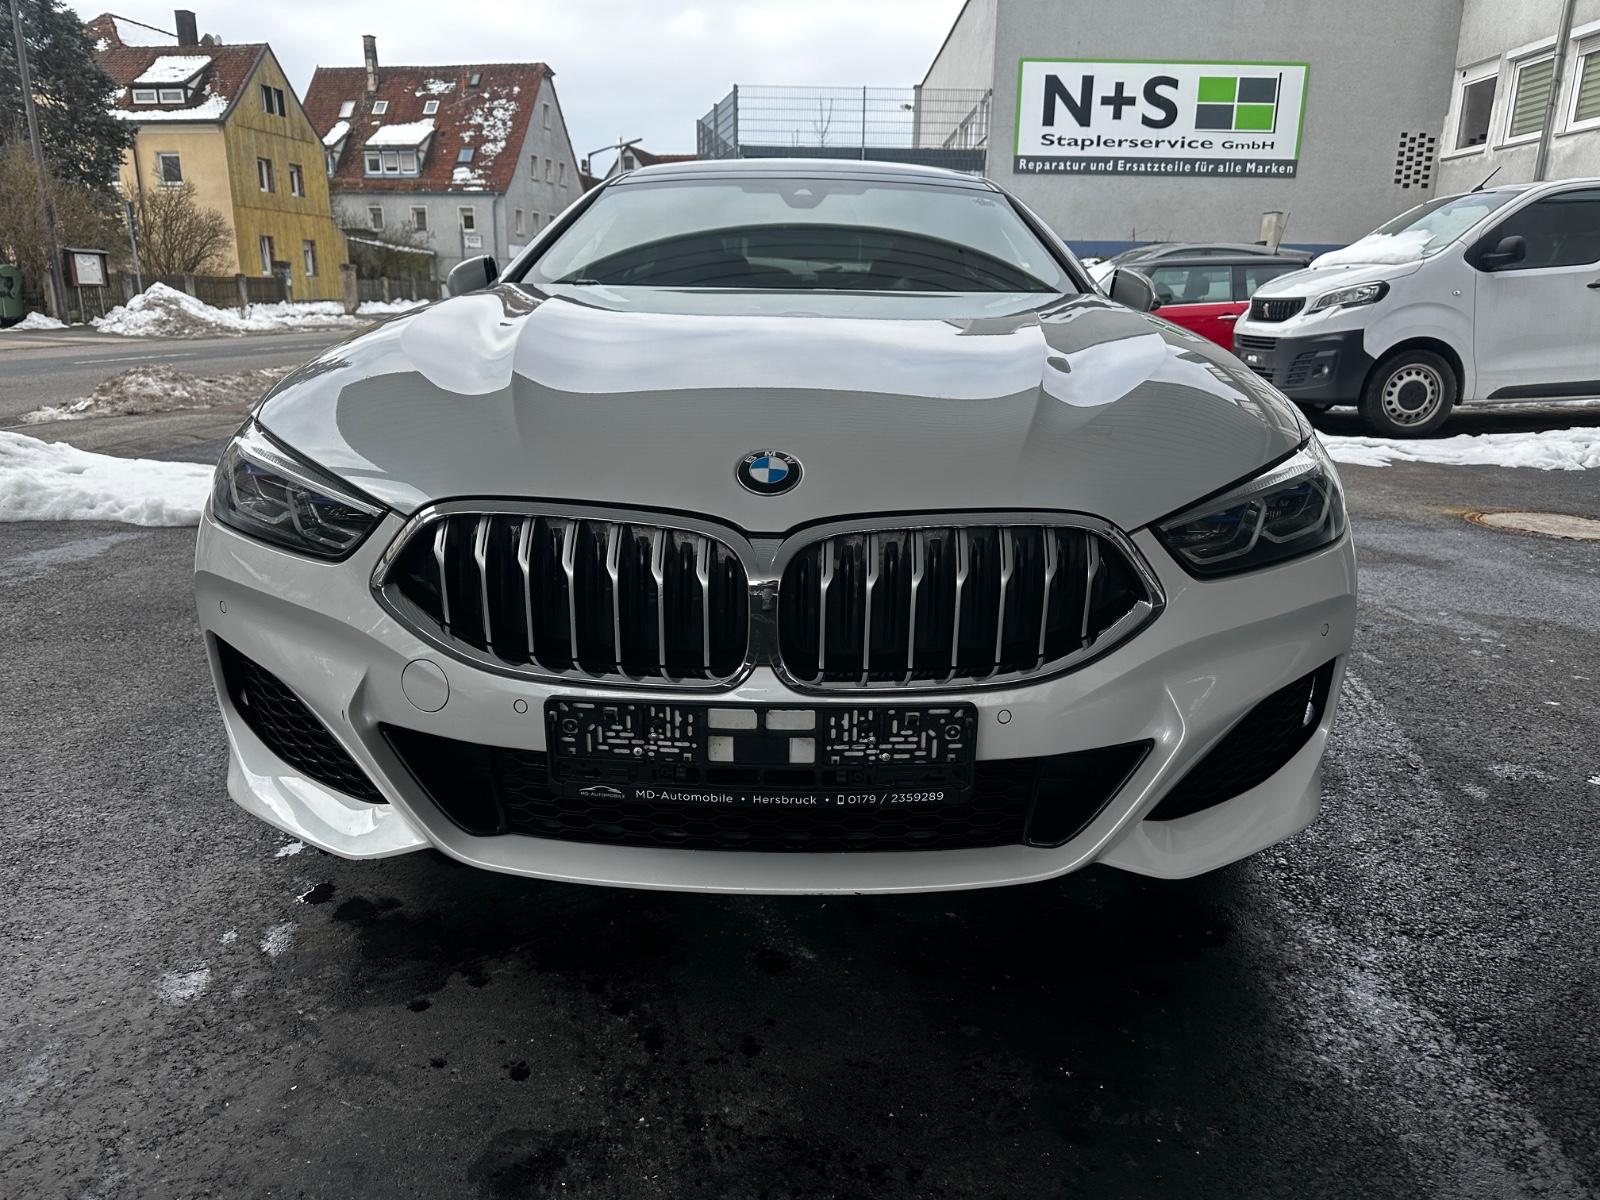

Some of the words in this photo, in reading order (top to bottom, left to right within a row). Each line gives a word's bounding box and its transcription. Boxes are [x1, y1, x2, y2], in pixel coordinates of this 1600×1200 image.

[1041, 74, 1179, 129] N+S
[1040, 133, 1214, 151] Staplerservice
[1221, 140, 1275, 150] GmbH
[1019, 158, 1086, 173] Reparatur
[1089, 160, 1114, 171] und
[1117, 160, 1191, 172] Ersatzteile
[1194, 161, 1215, 173] für
[1217, 162, 1242, 173] alle
[1245, 162, 1294, 174] Marken
[744, 451, 796, 464] BMW
[635, 789, 733, 803] MD-Automobile
[752, 795, 817, 805] Hersbruck
[847, 794, 877, 804] 0179
[891, 791, 944, 803] 2359289
